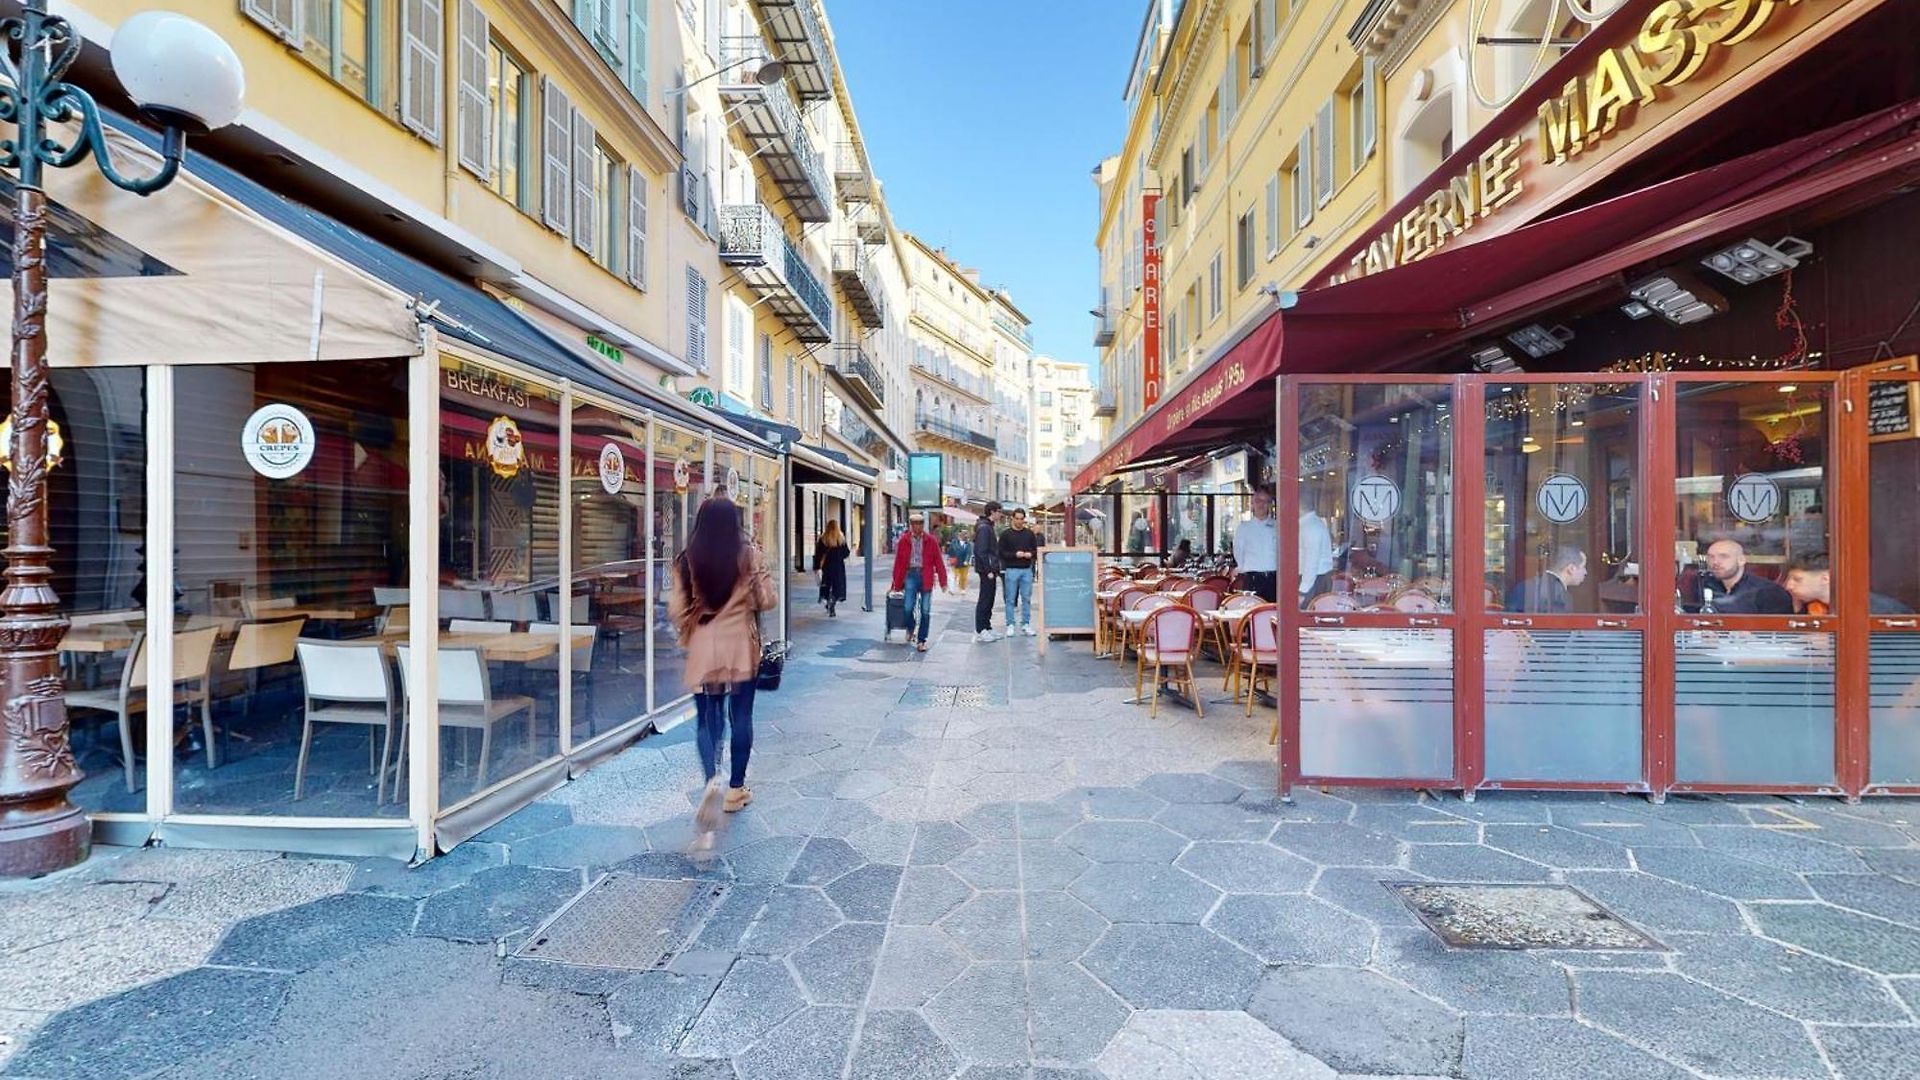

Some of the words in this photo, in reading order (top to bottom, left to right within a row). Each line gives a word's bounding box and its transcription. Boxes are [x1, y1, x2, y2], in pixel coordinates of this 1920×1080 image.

[1351, 134, 1523, 272] TAVERNE
[447, 370, 531, 408] BREAKFAST
[1201, 375, 1224, 407] depuis
[1224, 361, 1245, 391] 1956
